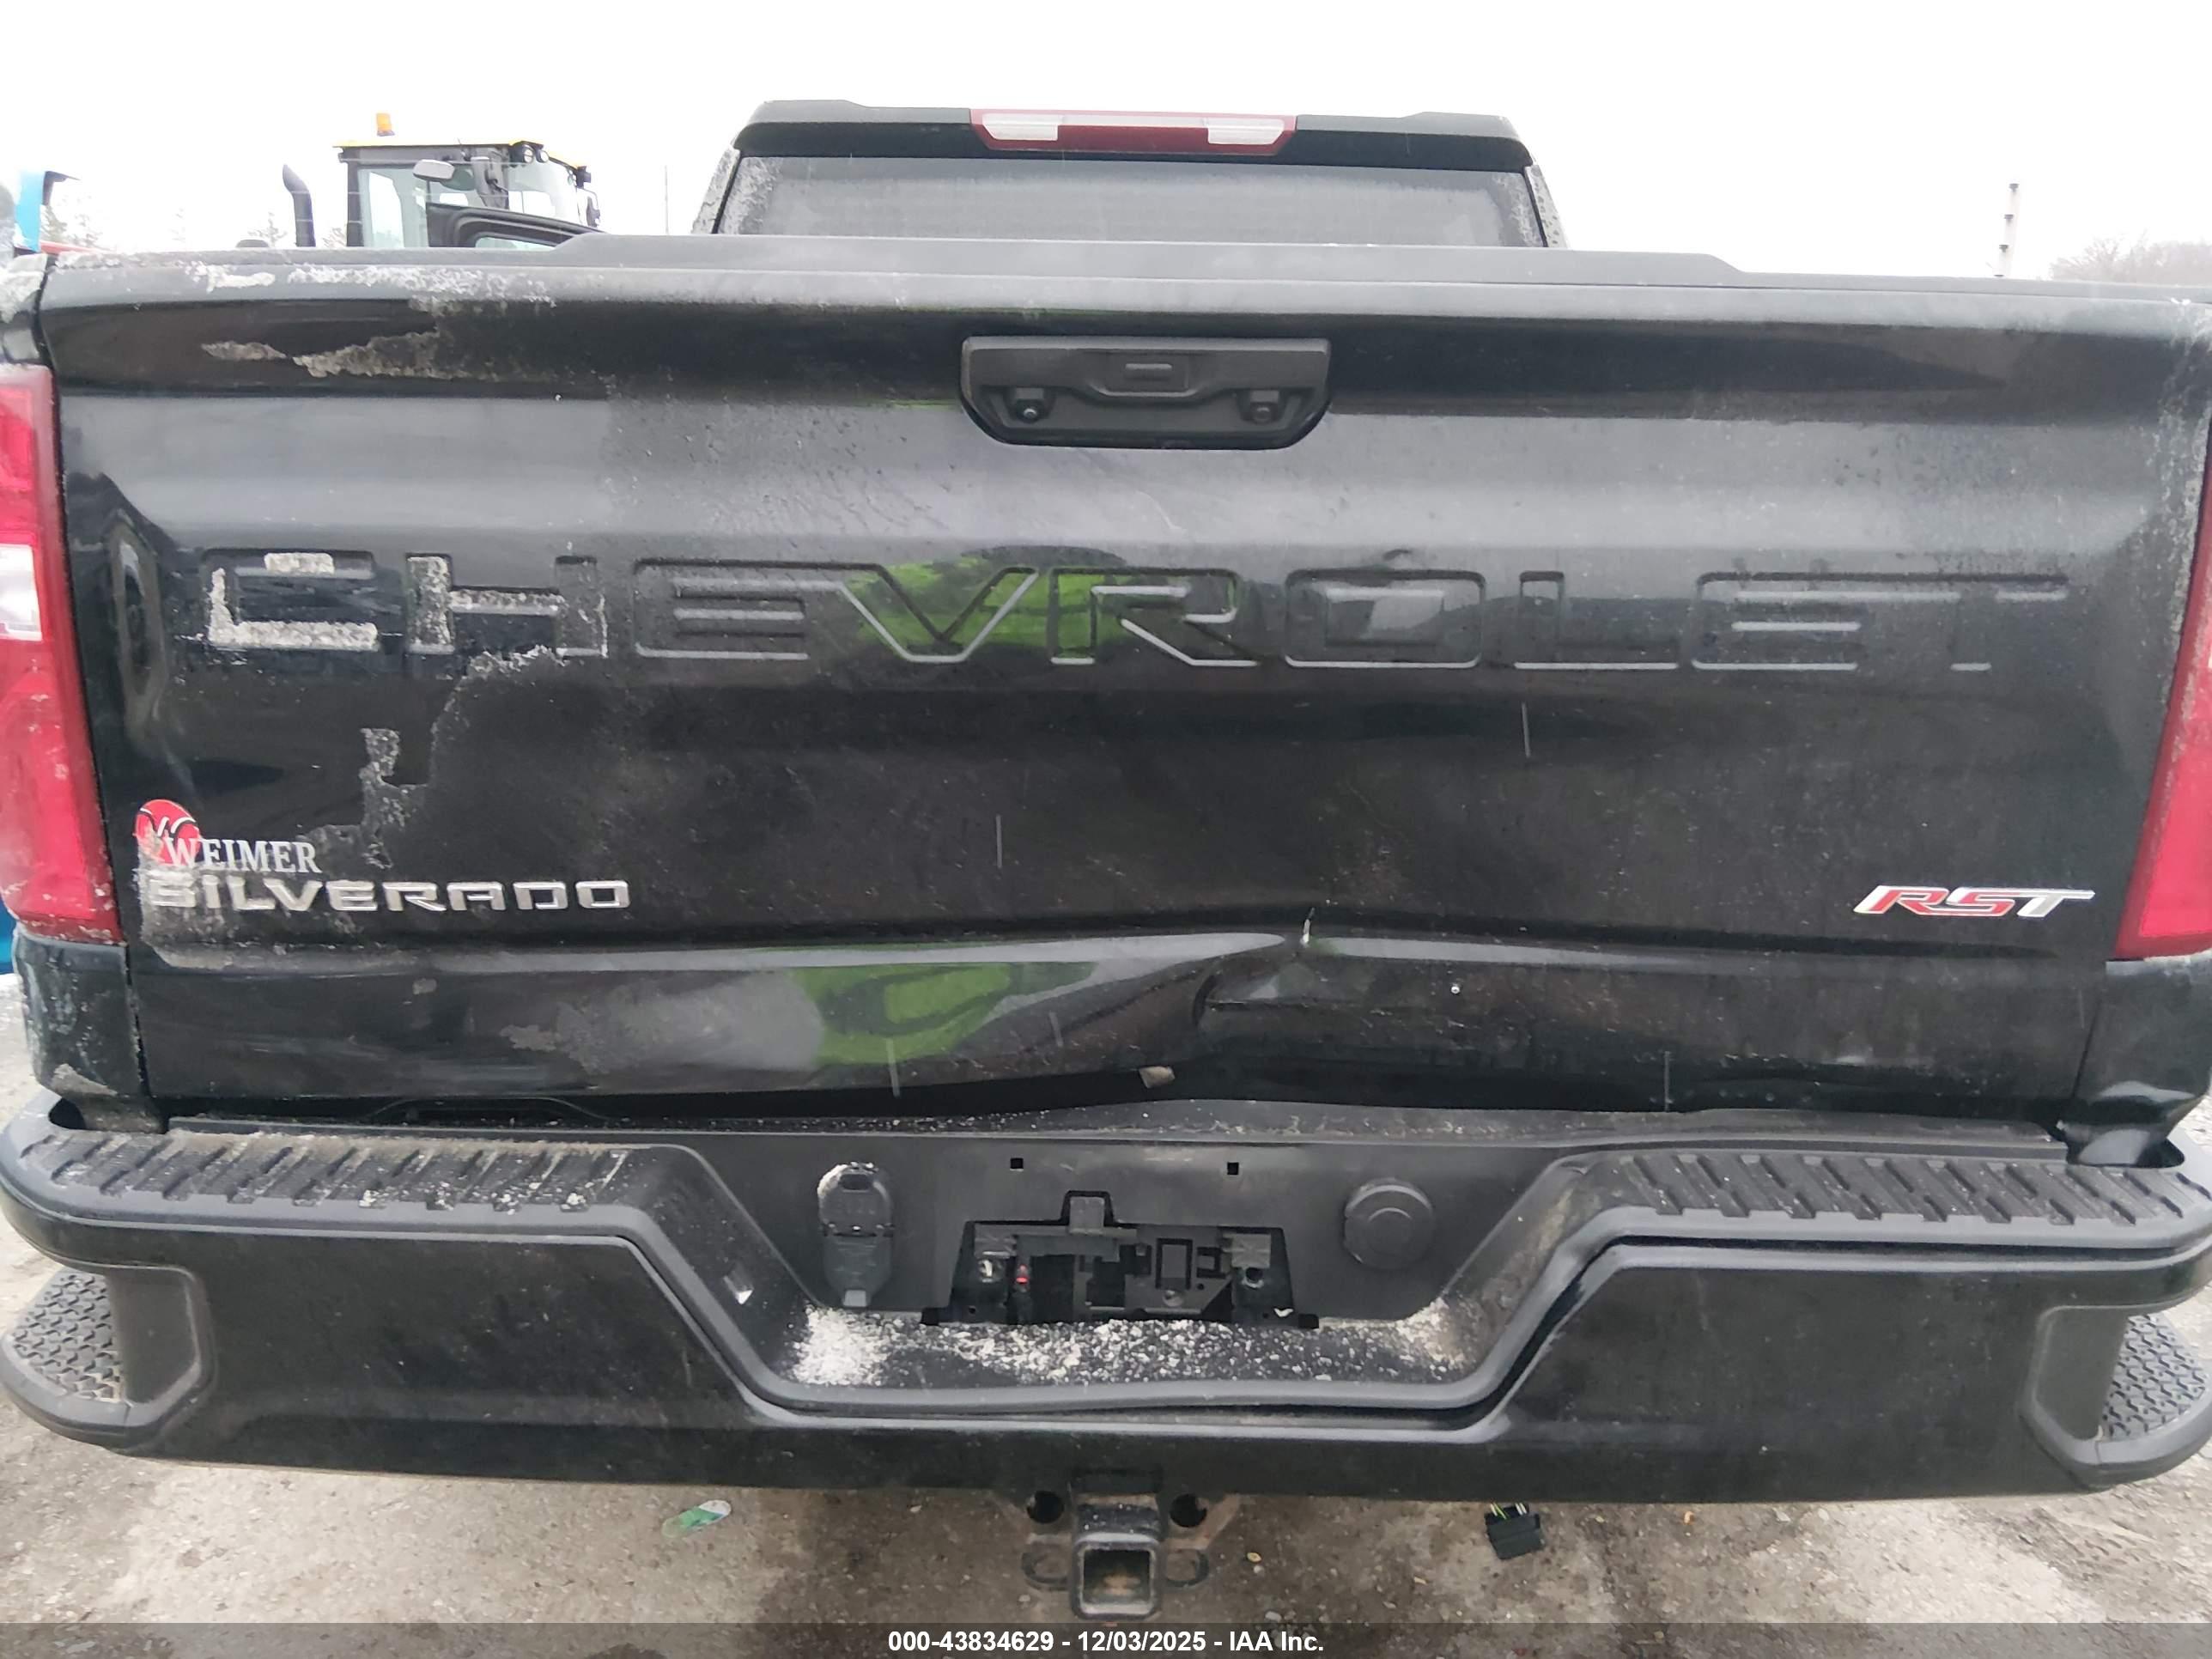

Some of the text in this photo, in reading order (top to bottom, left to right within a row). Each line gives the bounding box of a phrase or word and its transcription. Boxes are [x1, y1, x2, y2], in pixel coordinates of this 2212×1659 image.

[202, 548, 2068, 671] CHEVROLET
[165, 836, 323, 873] WEIMER
[146, 878, 630, 912] SILVERADO
[1853, 884, 2095, 918] RST
